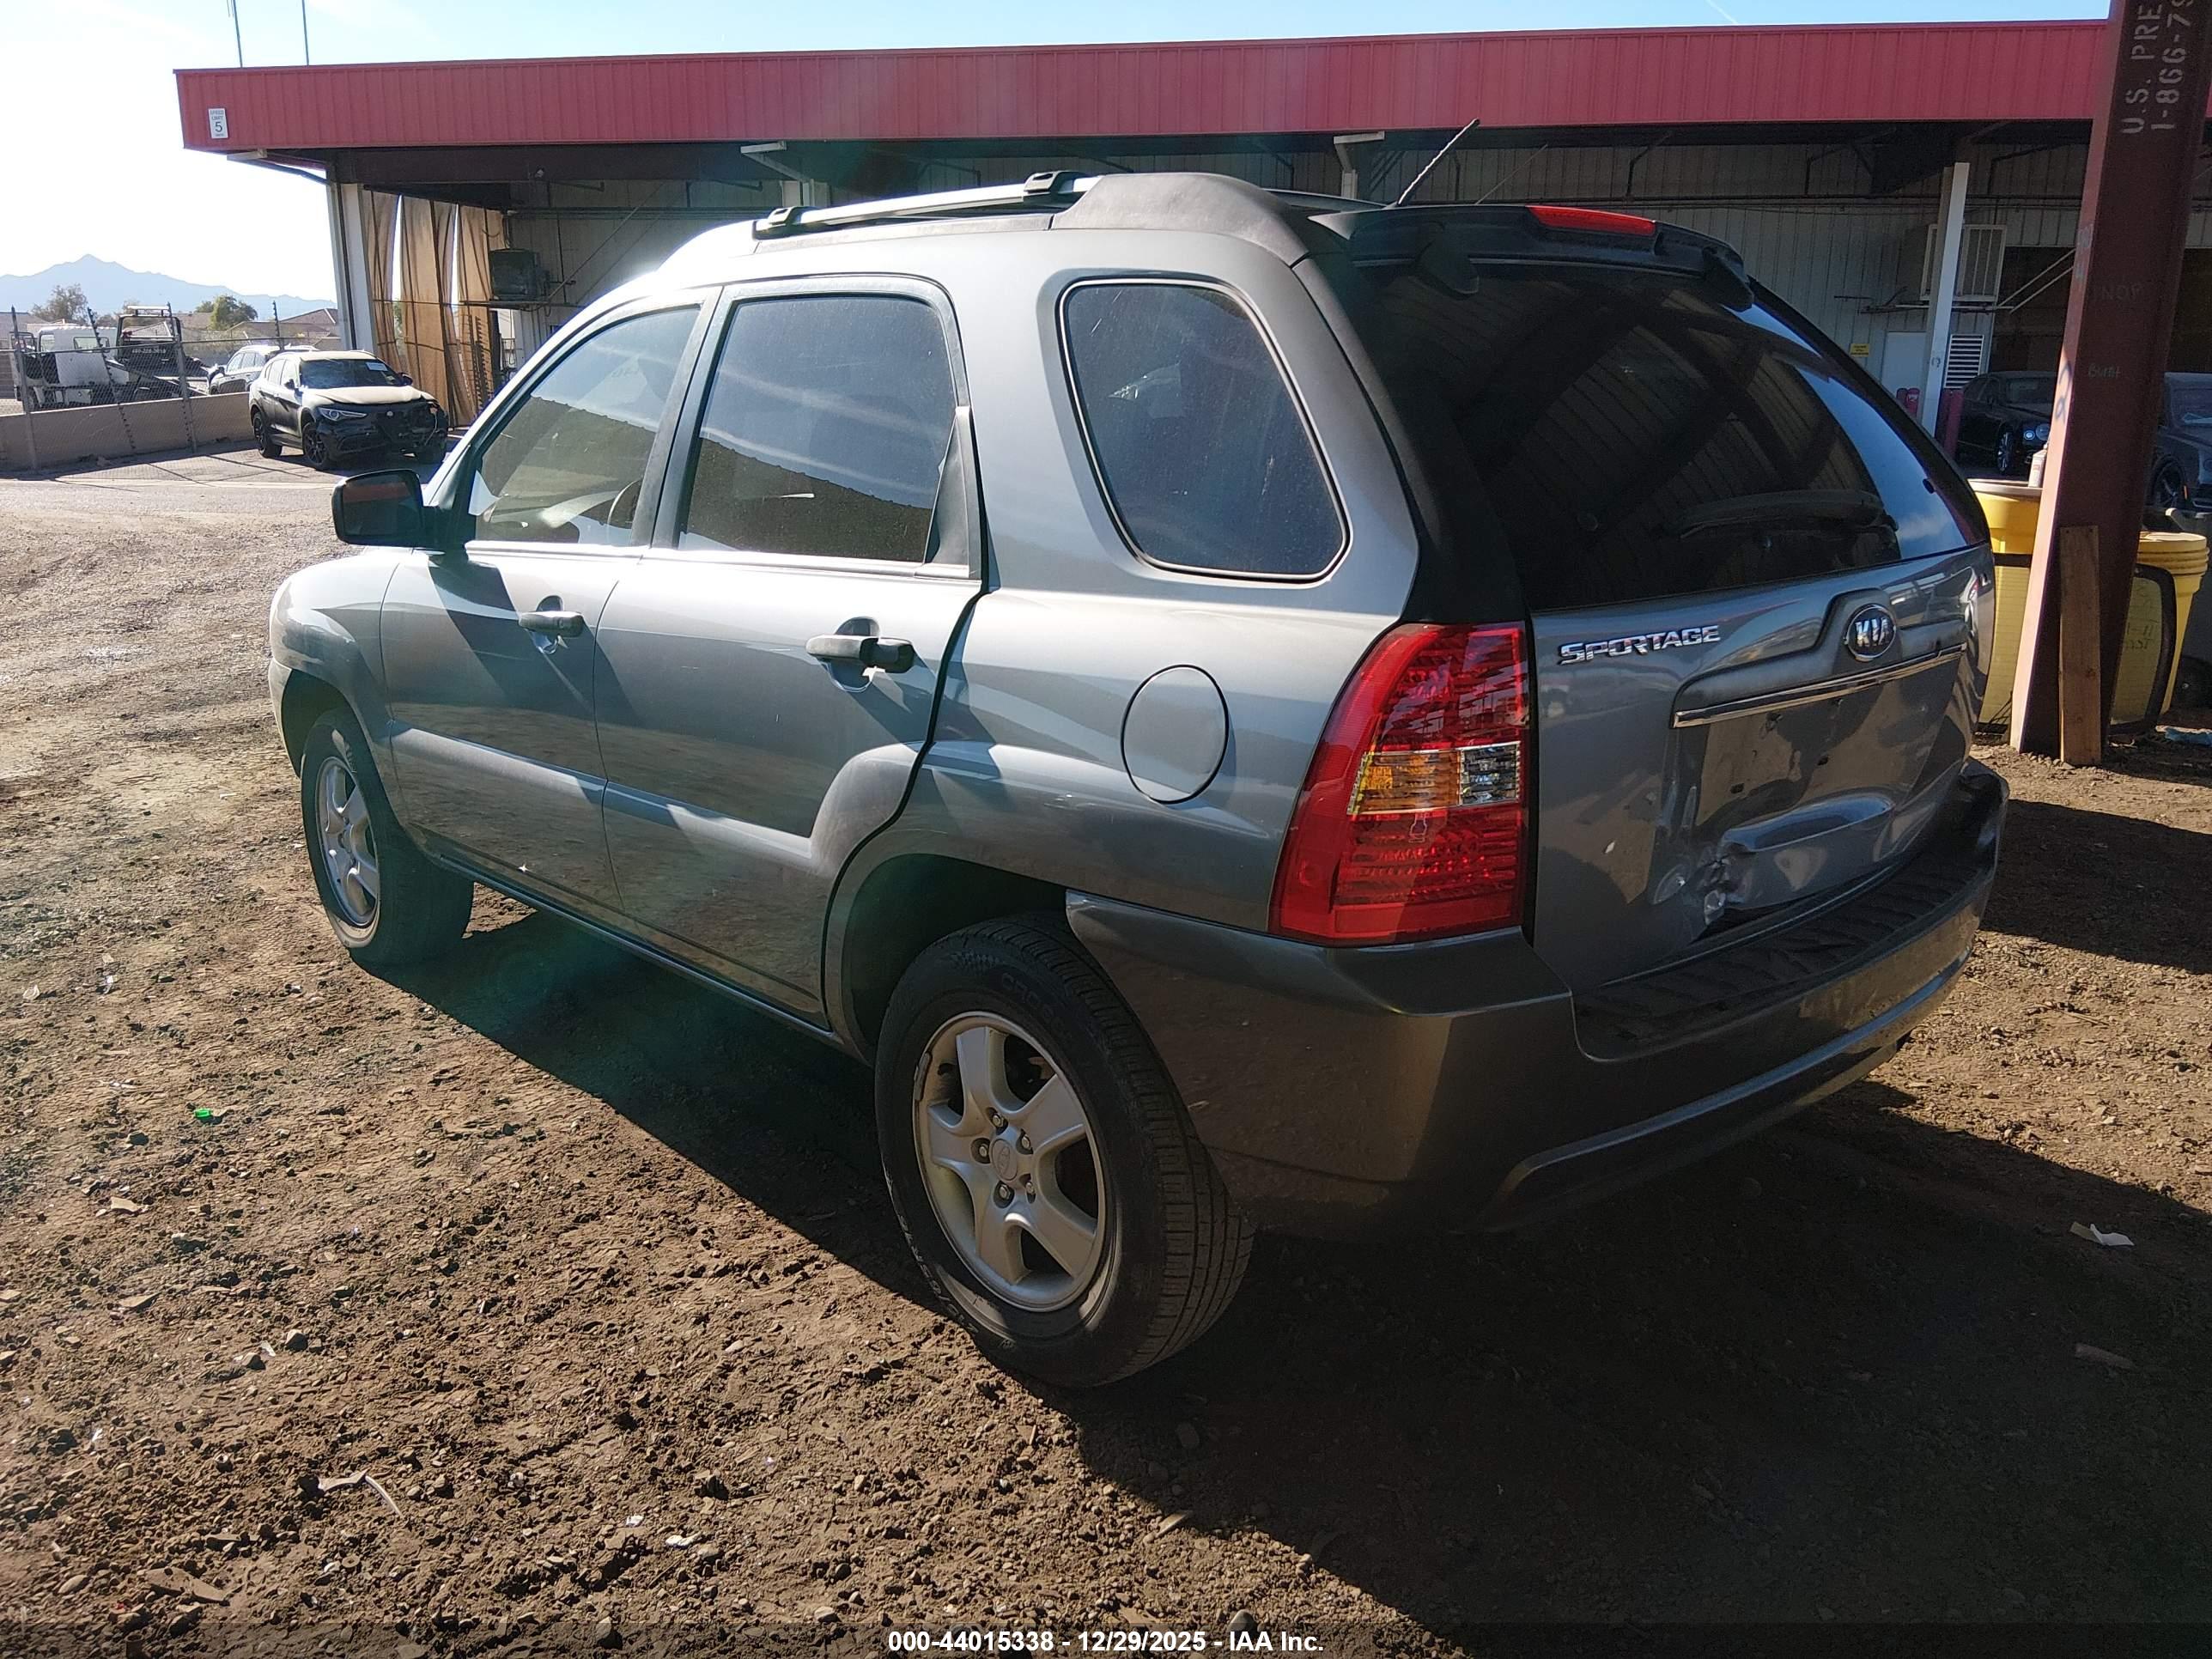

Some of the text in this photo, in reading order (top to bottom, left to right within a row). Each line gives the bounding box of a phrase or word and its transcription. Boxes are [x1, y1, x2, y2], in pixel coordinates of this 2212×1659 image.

[215, 121, 223, 132] 5
[2120, 79, 2151, 134] U.S.
[1559, 624, 1721, 665] SPORTAGE
